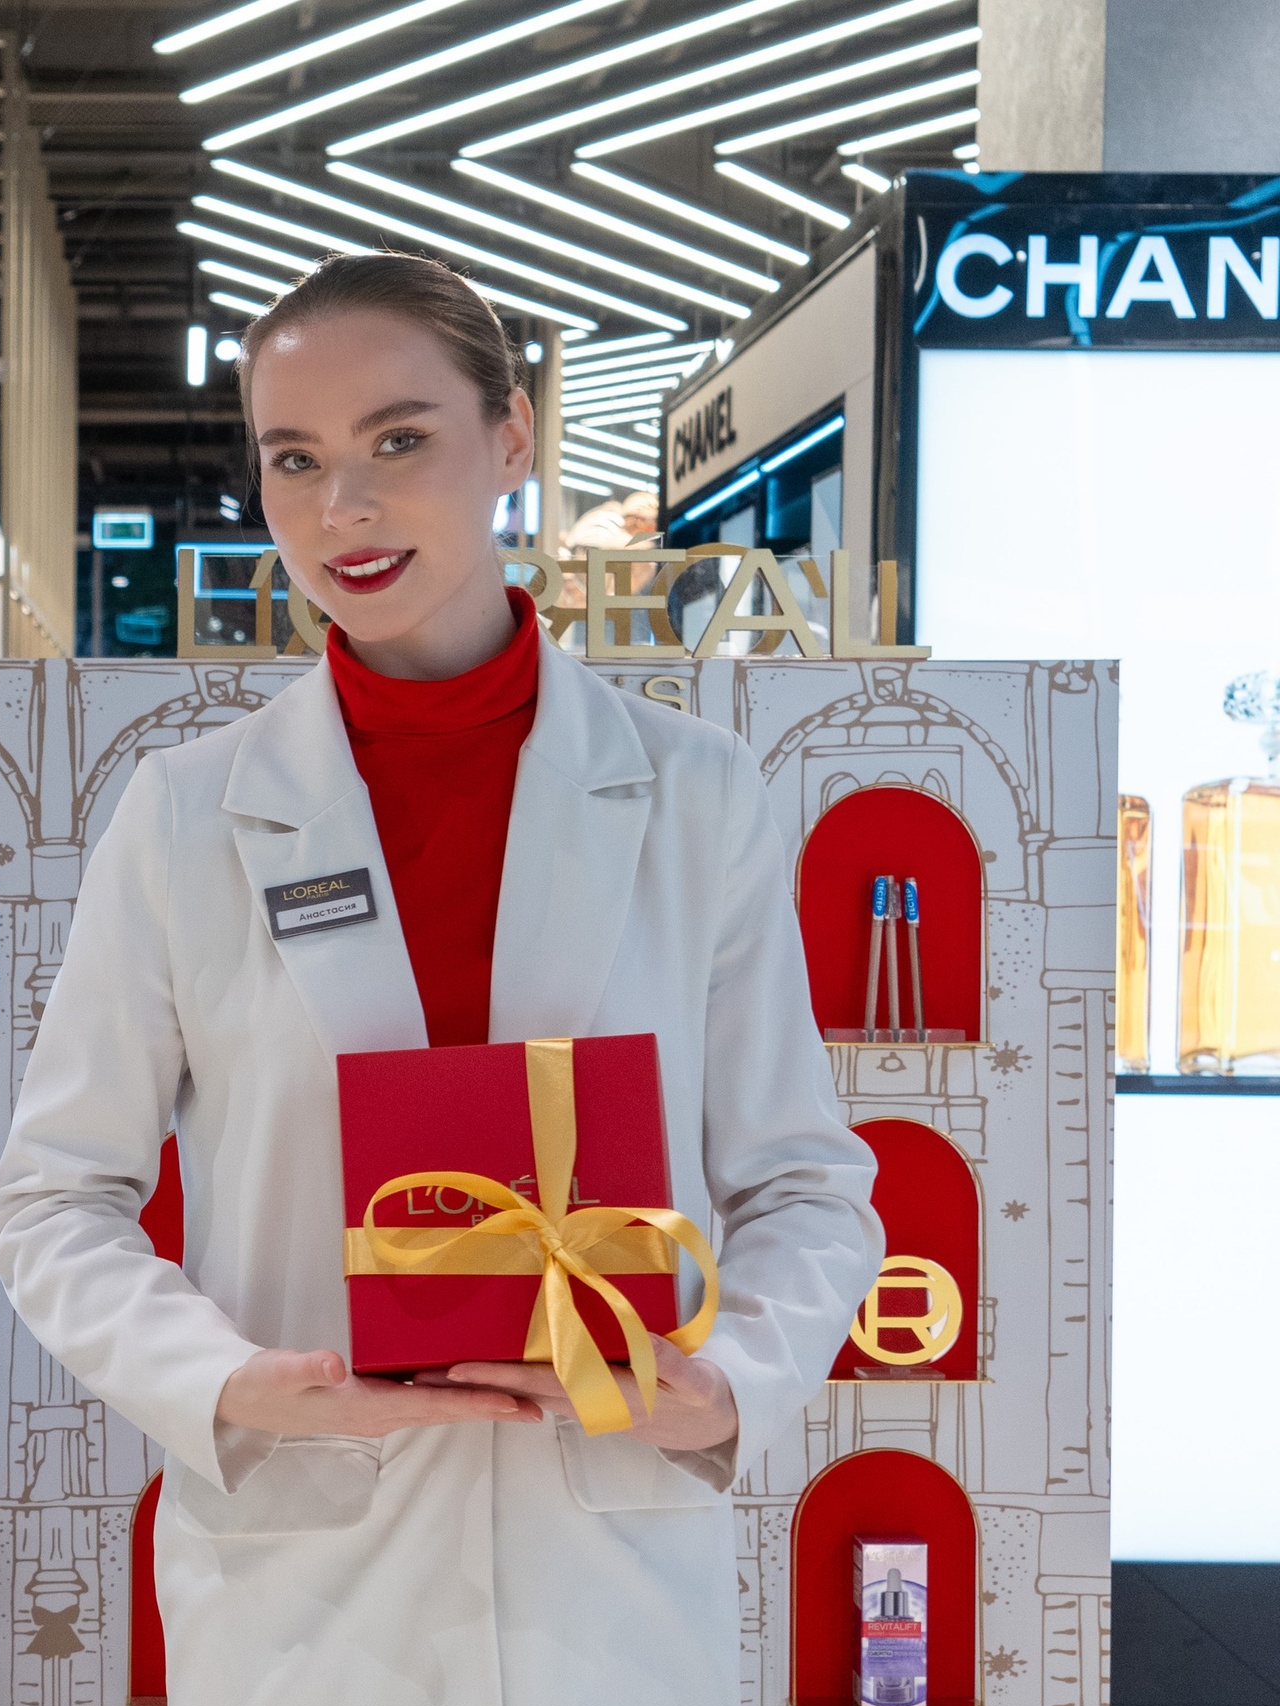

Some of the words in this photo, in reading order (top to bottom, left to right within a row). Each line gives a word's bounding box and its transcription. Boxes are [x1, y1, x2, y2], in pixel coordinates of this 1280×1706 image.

[936, 233, 1280, 319] CHAN
[673, 385, 737, 482] CHANEL
[283, 879, 350, 901] L'ORÉAL
[299, 902, 357, 922] Анастасия
[867, 1622, 918, 1631] REVITALIFT
